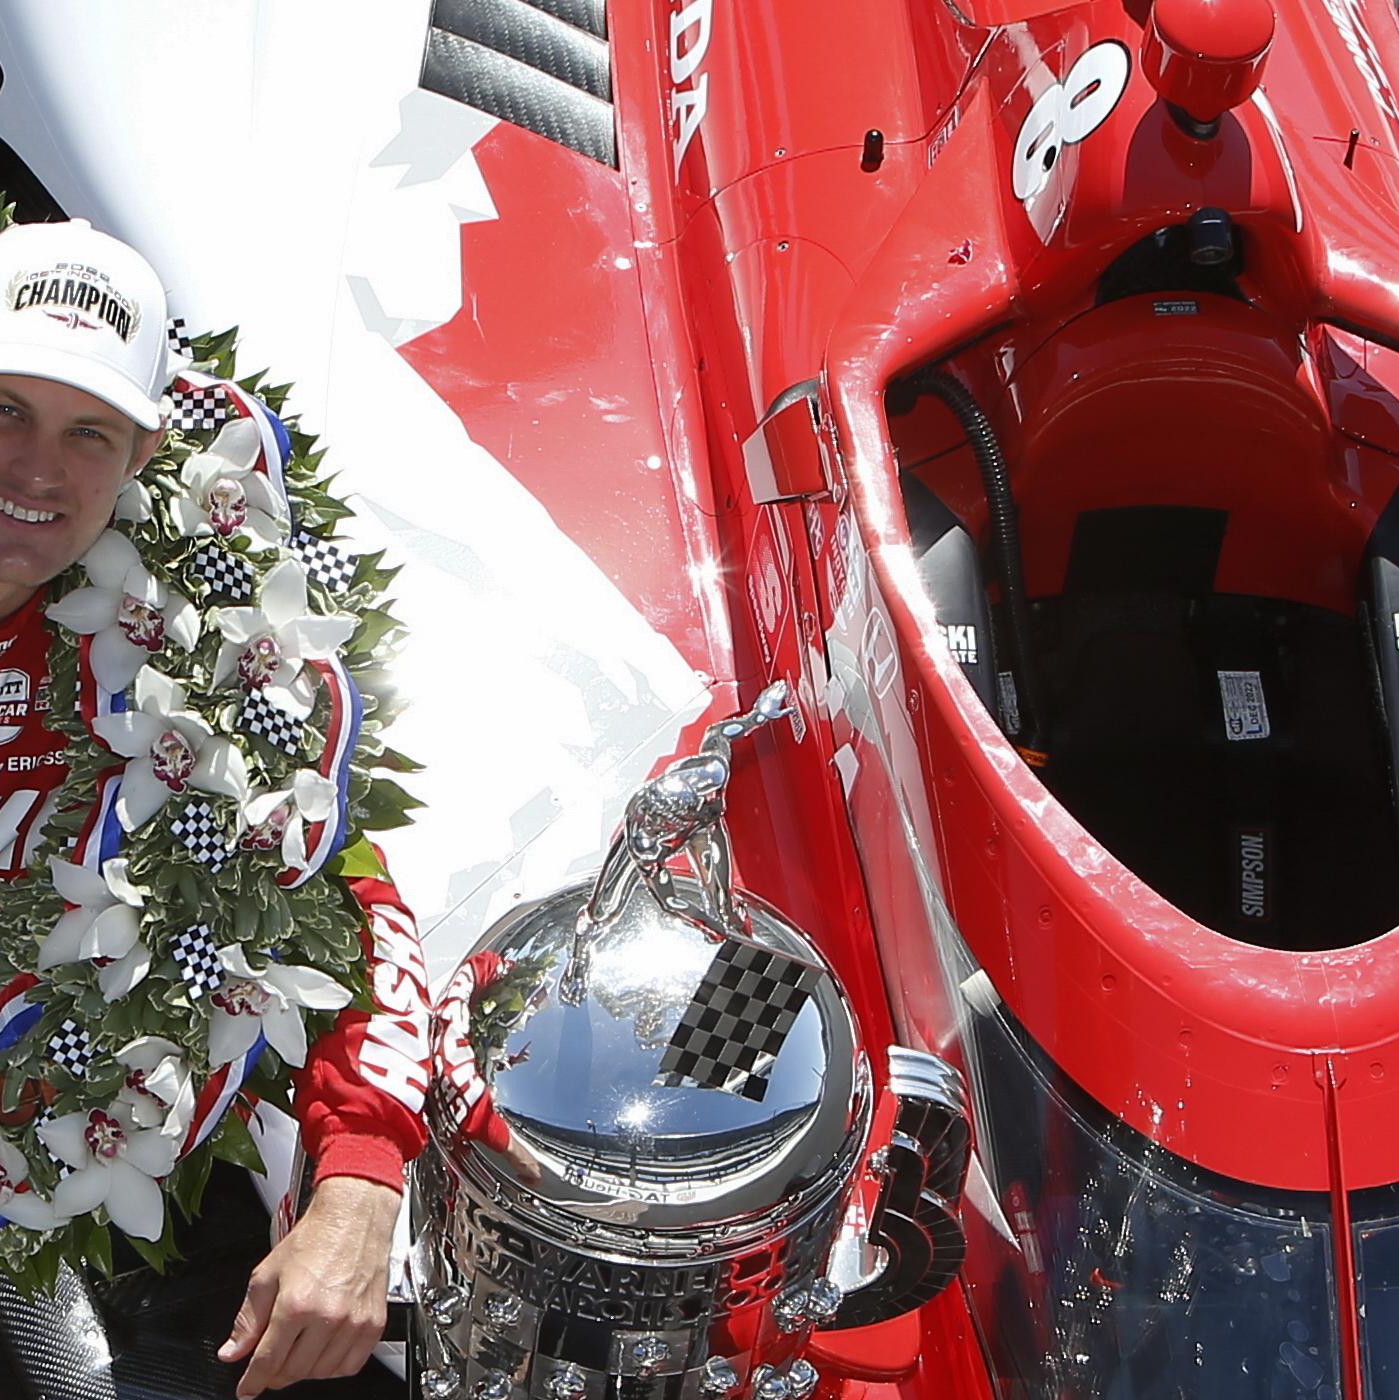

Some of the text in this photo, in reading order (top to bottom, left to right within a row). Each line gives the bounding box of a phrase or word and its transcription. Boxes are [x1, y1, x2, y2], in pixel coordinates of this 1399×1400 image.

[1012, 38, 1132, 201] 8
[14, 277, 134, 344] CHAMPION
[1240, 835, 1265, 917] SIMPSON
